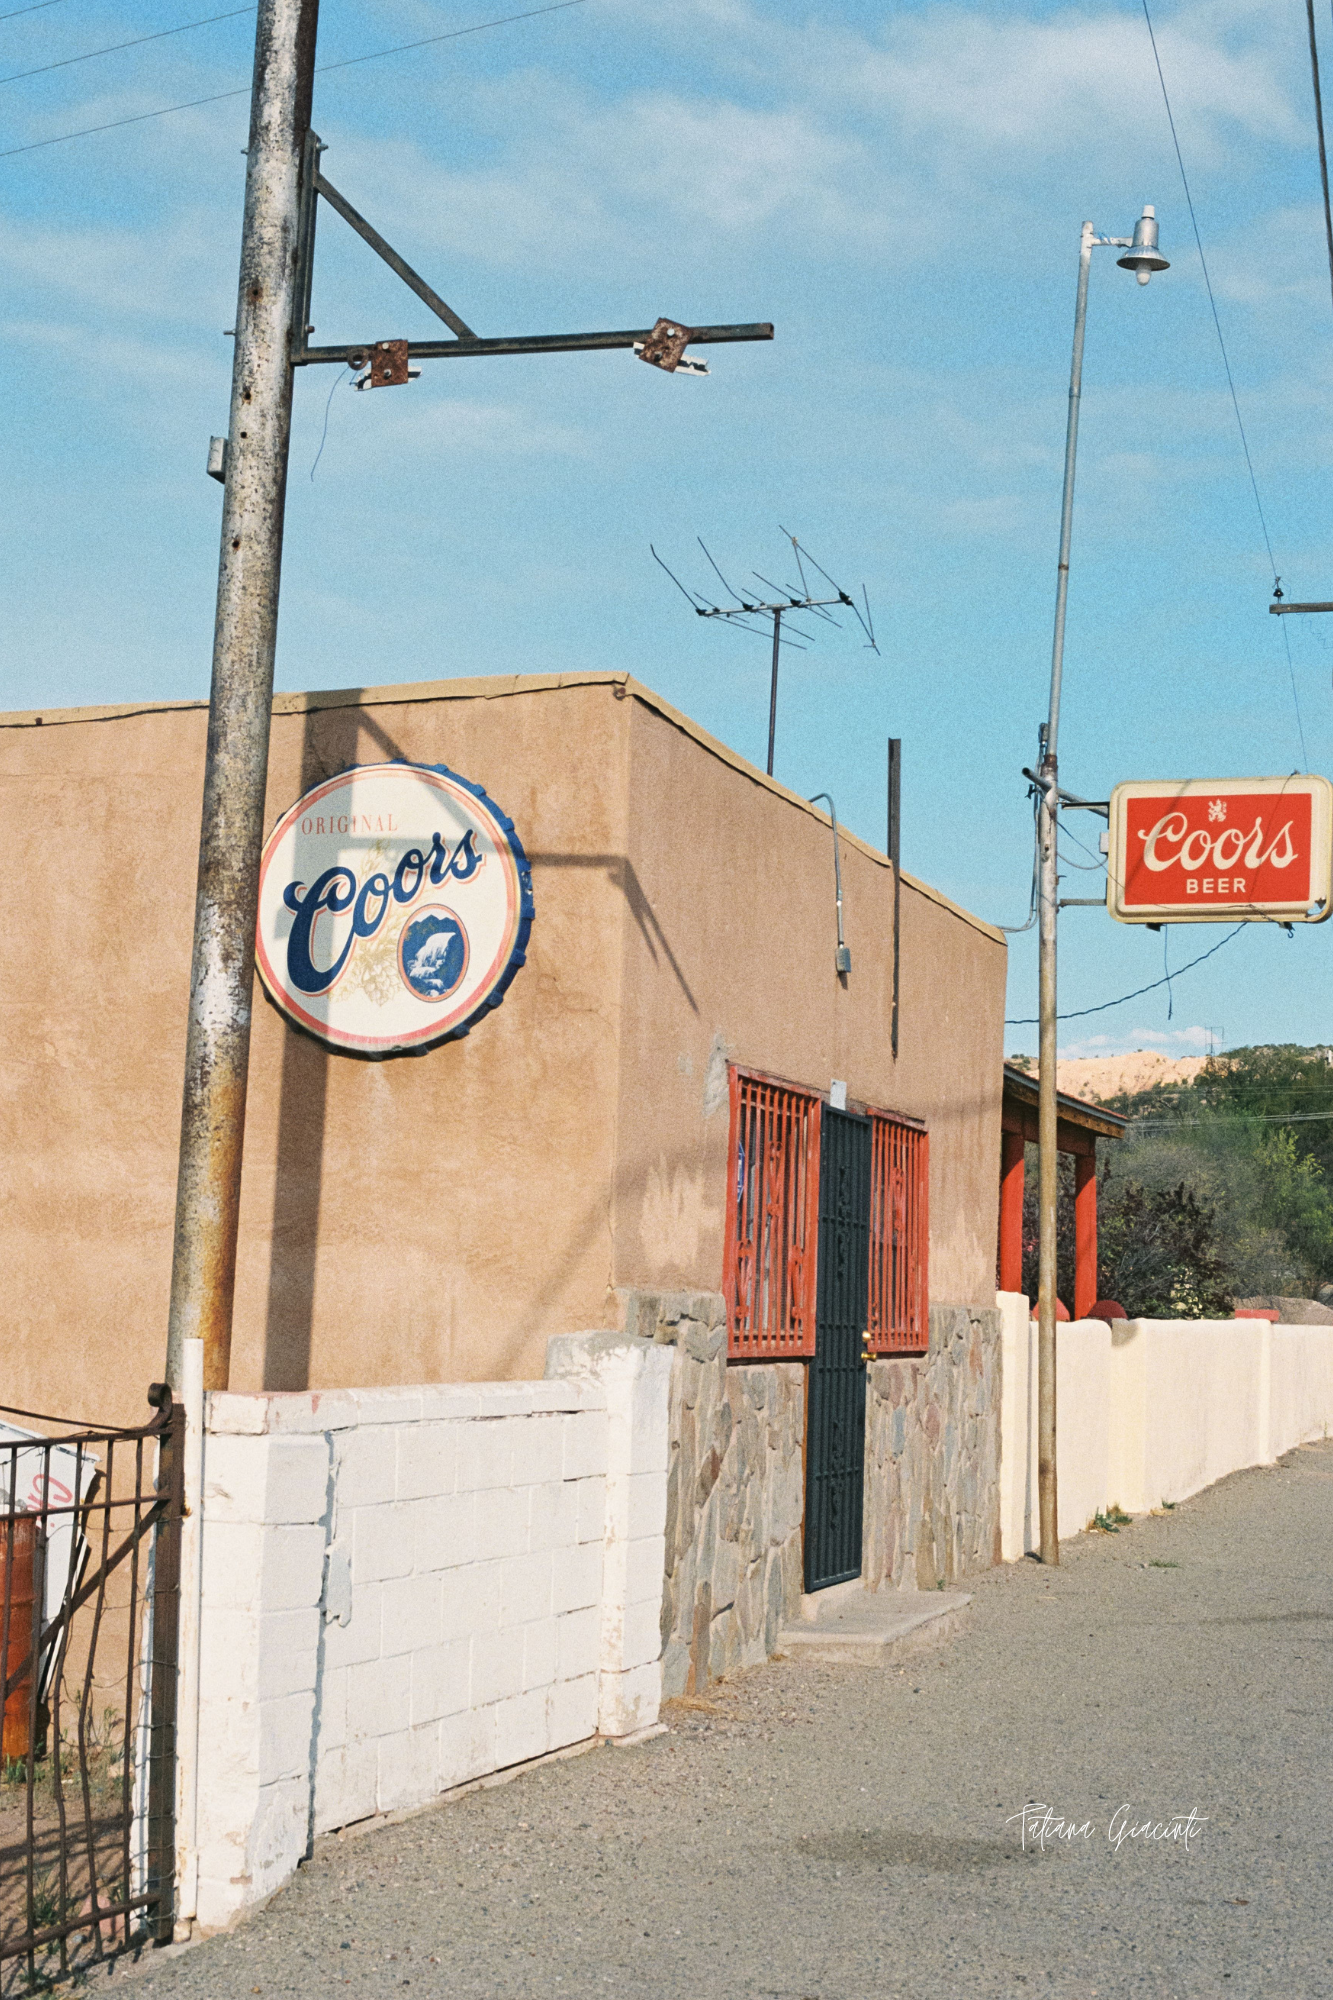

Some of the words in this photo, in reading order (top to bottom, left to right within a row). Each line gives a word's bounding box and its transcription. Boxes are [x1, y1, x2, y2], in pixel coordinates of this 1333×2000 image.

[301, 813, 398, 835] ORIGINAL
[1137, 812, 1299, 872] Coors
[1186, 878, 1247, 894] BEER
[283, 829, 485, 994] Coors
